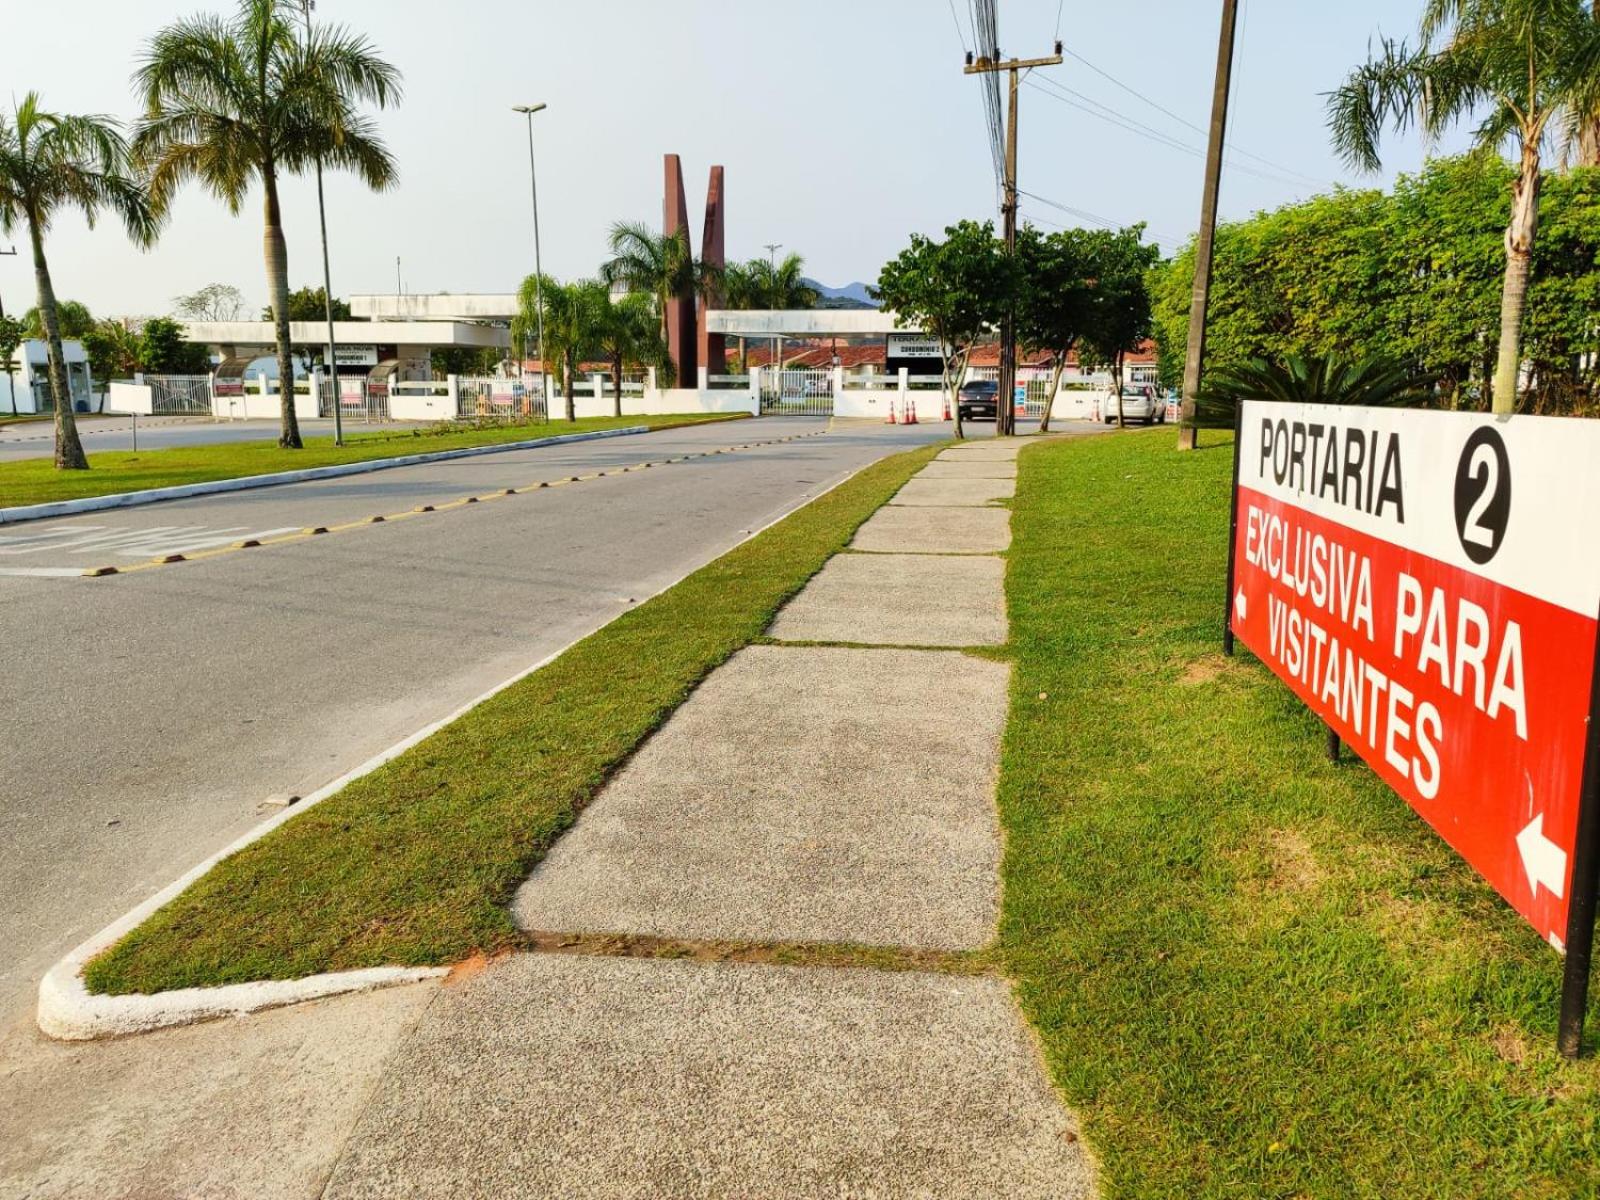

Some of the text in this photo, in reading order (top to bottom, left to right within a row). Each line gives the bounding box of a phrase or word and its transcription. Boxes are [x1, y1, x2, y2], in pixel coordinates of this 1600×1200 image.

[1260, 418, 1495, 548] PORTARIA 2
[1245, 505, 1527, 741] EXCLUSIVA PARA
[1268, 593, 1443, 800] VISITANTES
